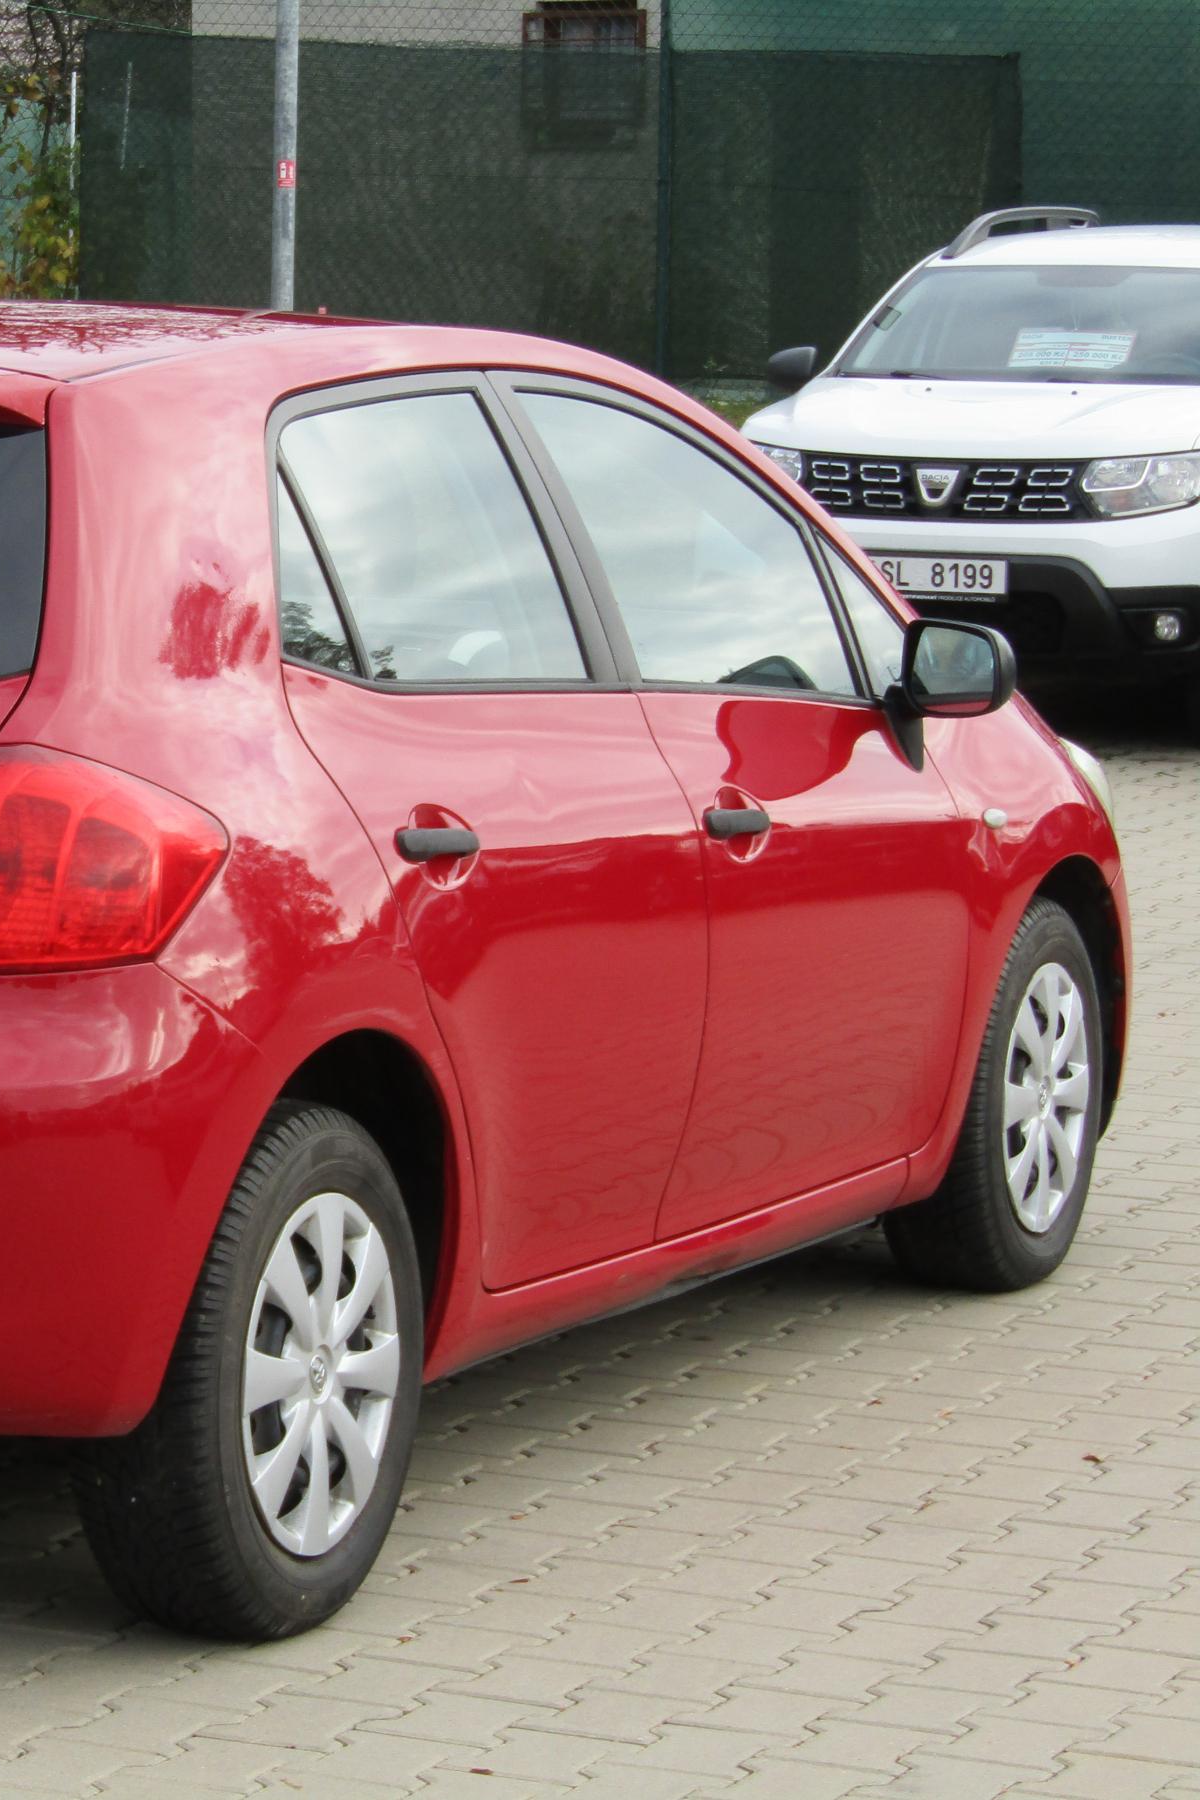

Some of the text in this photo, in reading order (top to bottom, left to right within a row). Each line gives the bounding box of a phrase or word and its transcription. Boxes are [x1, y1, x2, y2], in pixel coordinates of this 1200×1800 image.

[921, 473, 950, 481] DACIA
[872, 559, 993, 589] SL 8199
